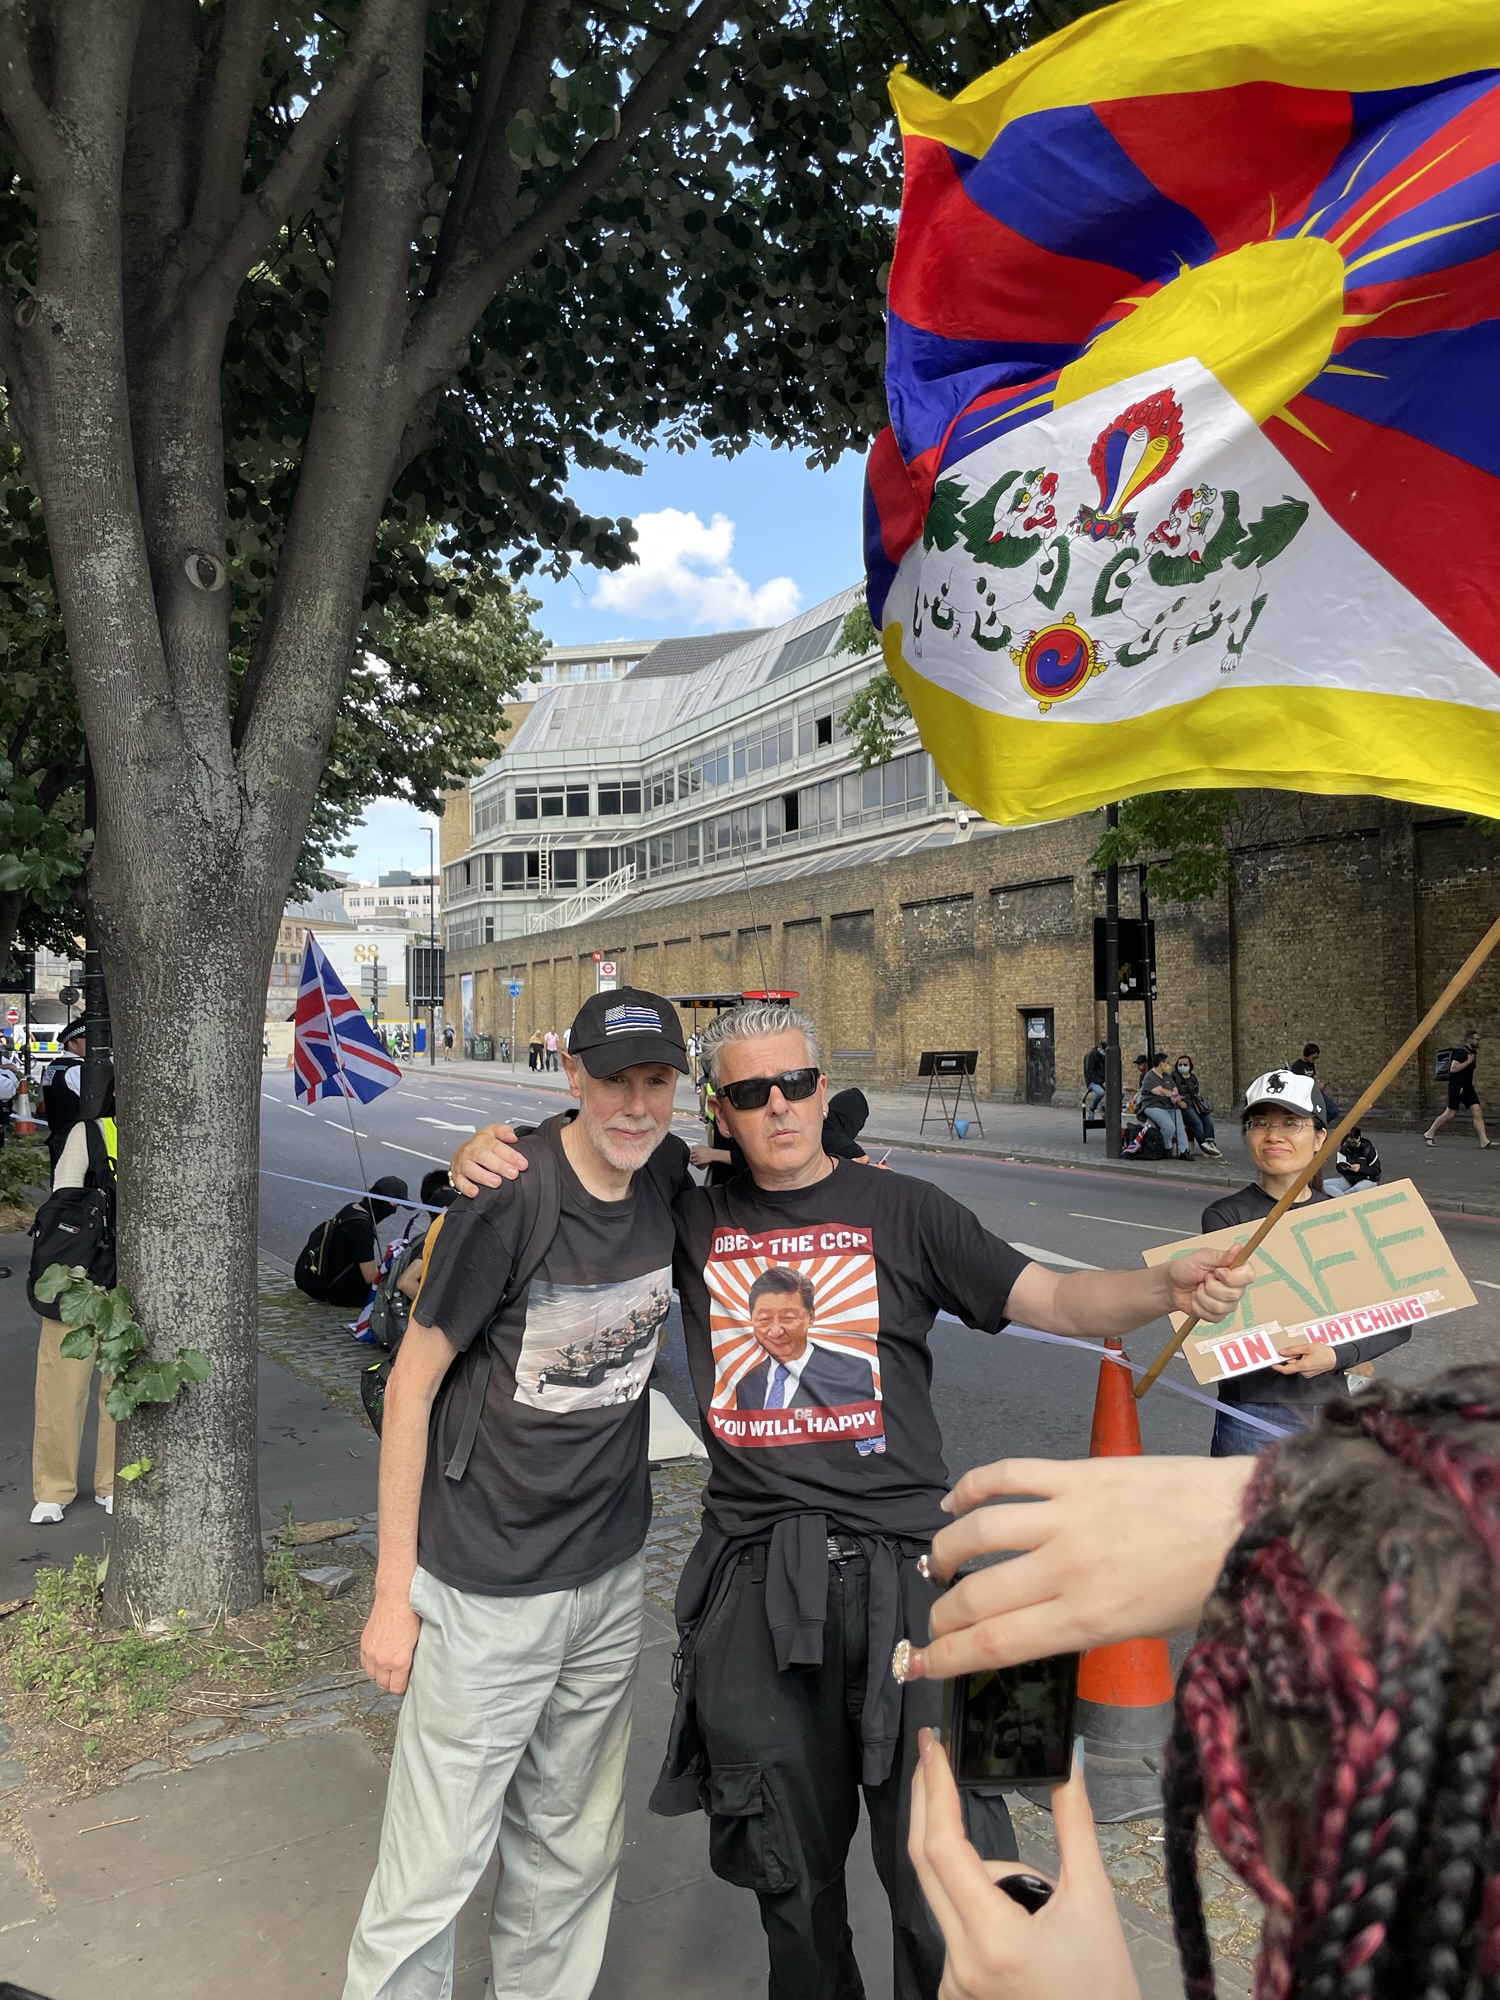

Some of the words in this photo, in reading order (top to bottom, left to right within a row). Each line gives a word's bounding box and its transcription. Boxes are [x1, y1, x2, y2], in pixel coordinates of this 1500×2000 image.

[354, 943, 380, 963] 88
[769, 1234, 814, 1255] THE
[820, 1231, 868, 1249] CCP
[1219, 1333, 1272, 1371] ON
[1306, 1298, 1425, 1345] WATCHING
[713, 1415, 746, 1437] YOU
[750, 1419, 802, 1437] WILL
[807, 1409, 876, 1433] HAPPY
[794, 1408, 812, 1420] BE
